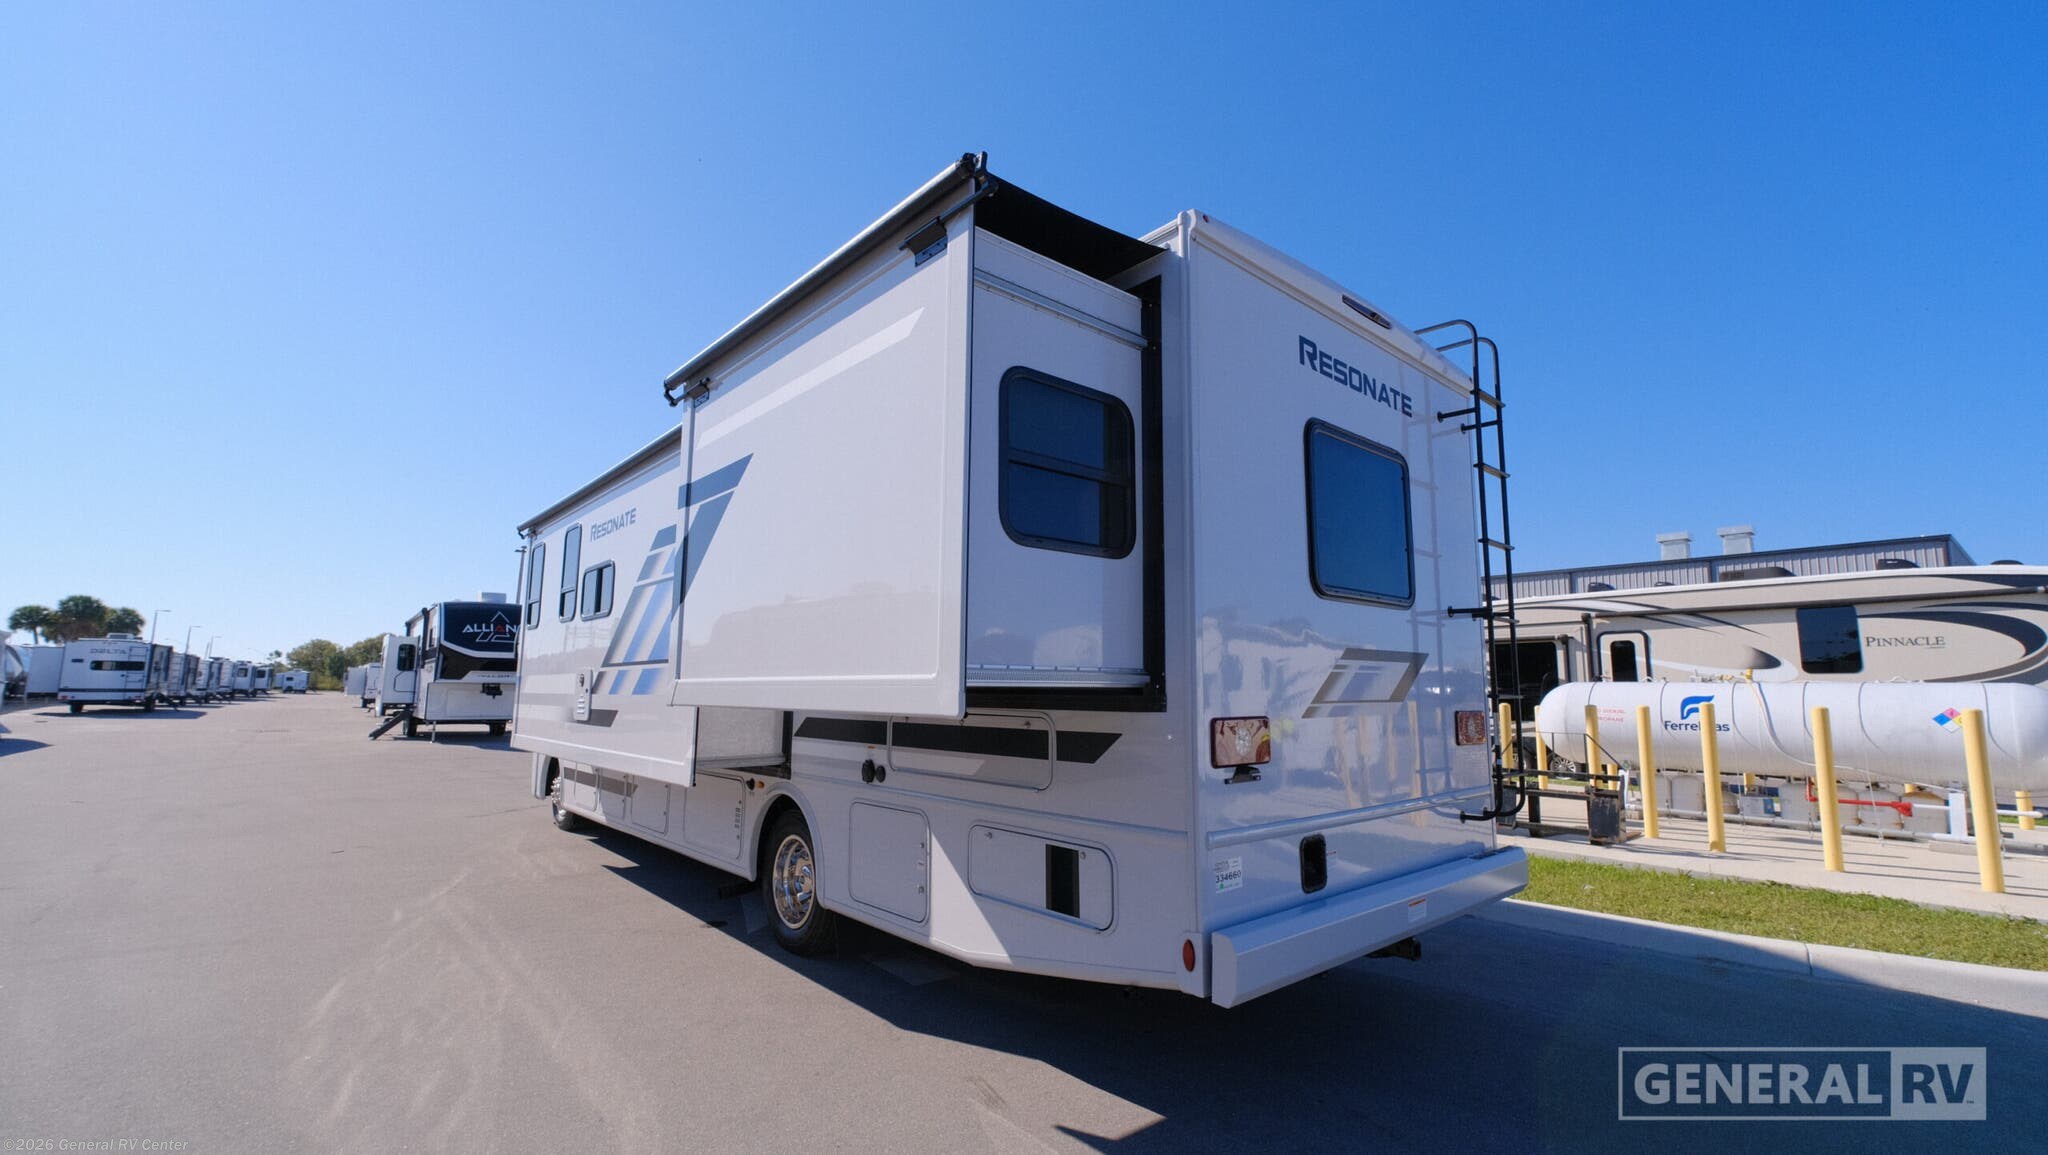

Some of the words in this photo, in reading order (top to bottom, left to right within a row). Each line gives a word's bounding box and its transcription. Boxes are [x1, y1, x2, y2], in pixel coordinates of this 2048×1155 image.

[1299, 335, 1413, 418] RESONATE
[590, 507, 637, 542] RESONATE
[462, 624, 517, 633] ALLIAN
[1866, 636, 1947, 647] PINNACLE
